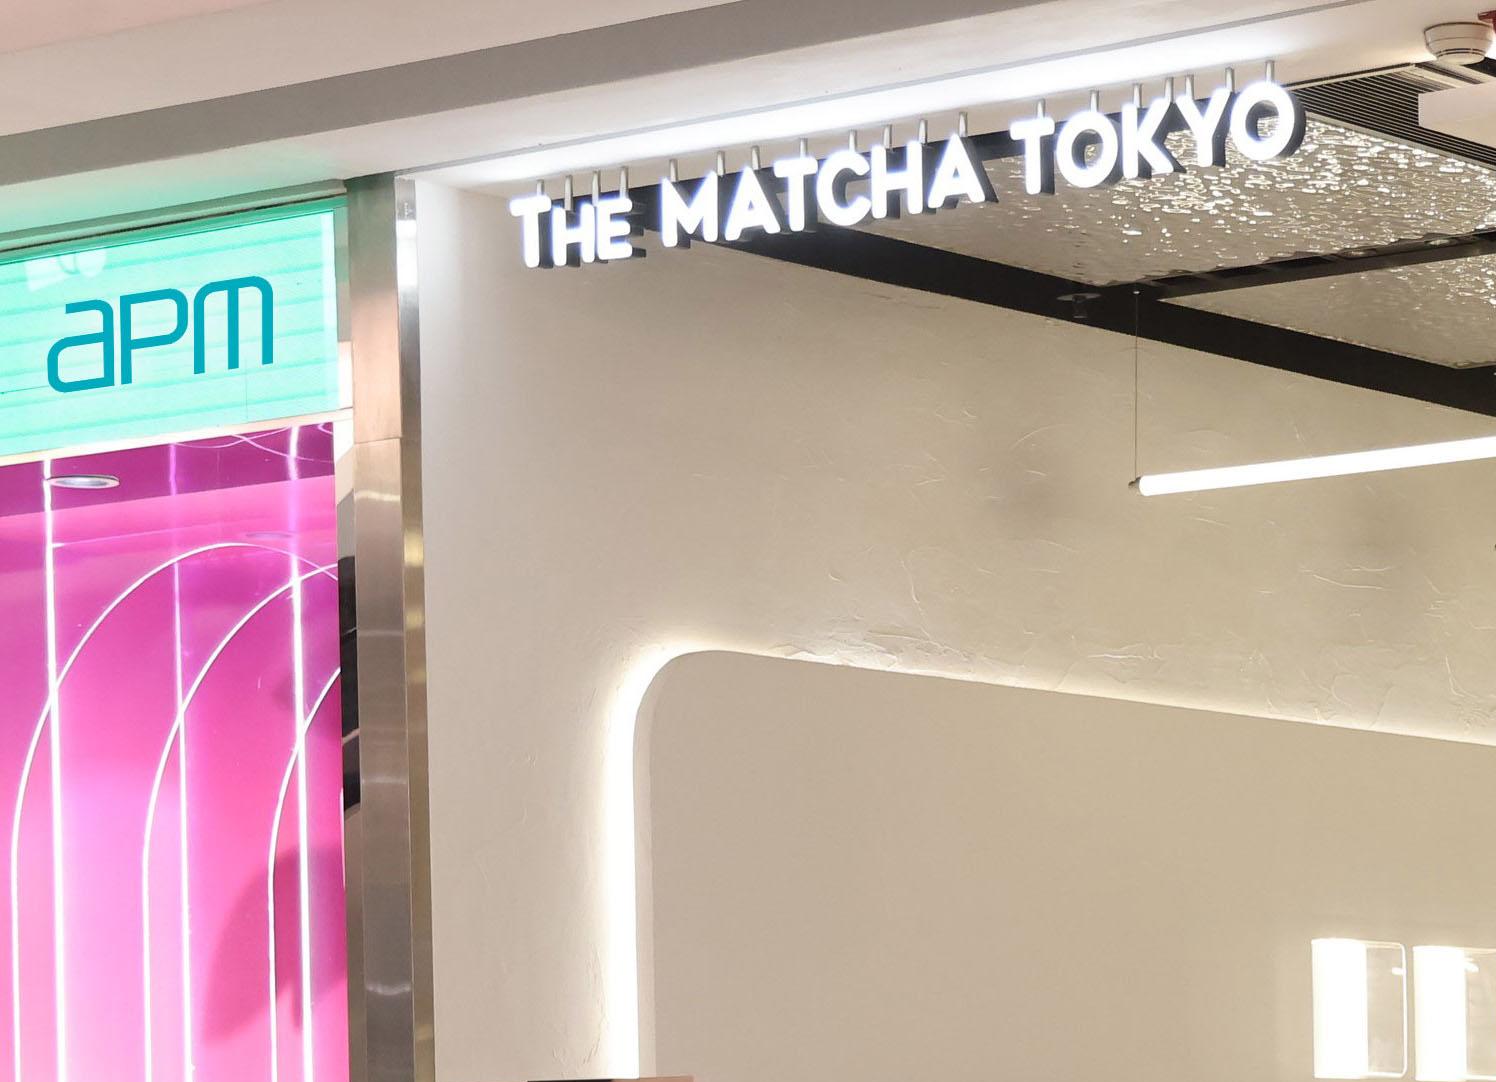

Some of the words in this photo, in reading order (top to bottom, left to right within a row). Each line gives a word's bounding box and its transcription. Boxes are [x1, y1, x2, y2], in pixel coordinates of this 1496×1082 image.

[509, 192, 633, 268] THE
[661, 133, 986, 248] MATCHA
[1010, 80, 1296, 195] TOKYO
